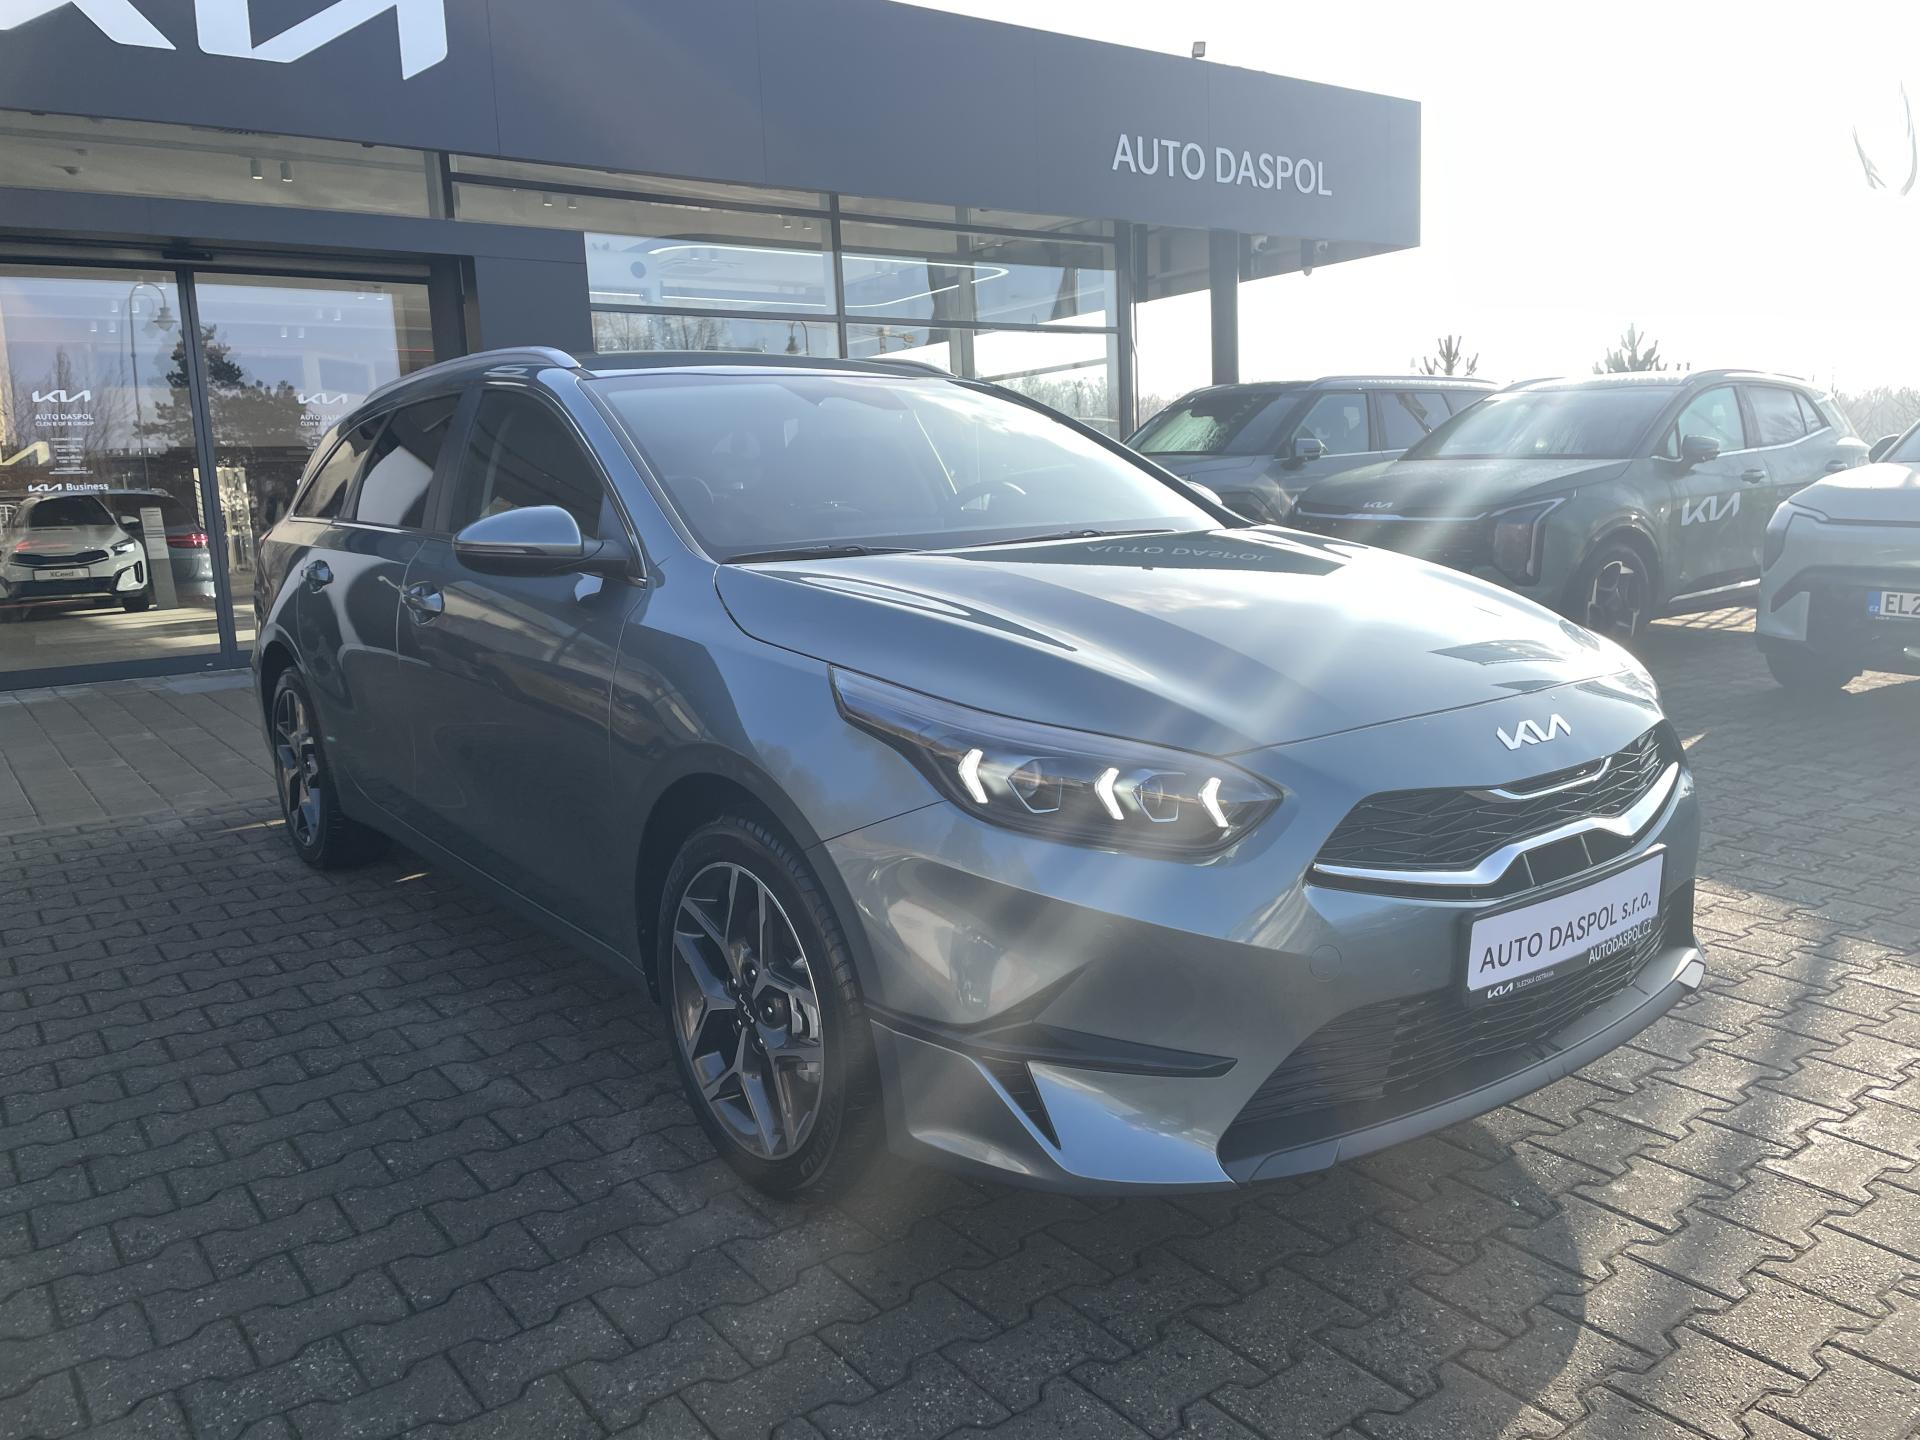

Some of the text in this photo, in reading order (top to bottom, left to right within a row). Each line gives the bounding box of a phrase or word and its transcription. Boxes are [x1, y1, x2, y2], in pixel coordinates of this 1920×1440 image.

[1112, 133, 1333, 196] AUTO DASPOL
[32, 389, 91, 402] KIA
[298, 392, 348, 404] KIA
[28, 482, 109, 492] KIA Business
[1681, 492, 1740, 526] KIA
[1496, 713, 1571, 750] KIA
[1479, 892, 1651, 973] AUTO DASPOL s.r.o.
[1487, 982, 1514, 999] KIA
